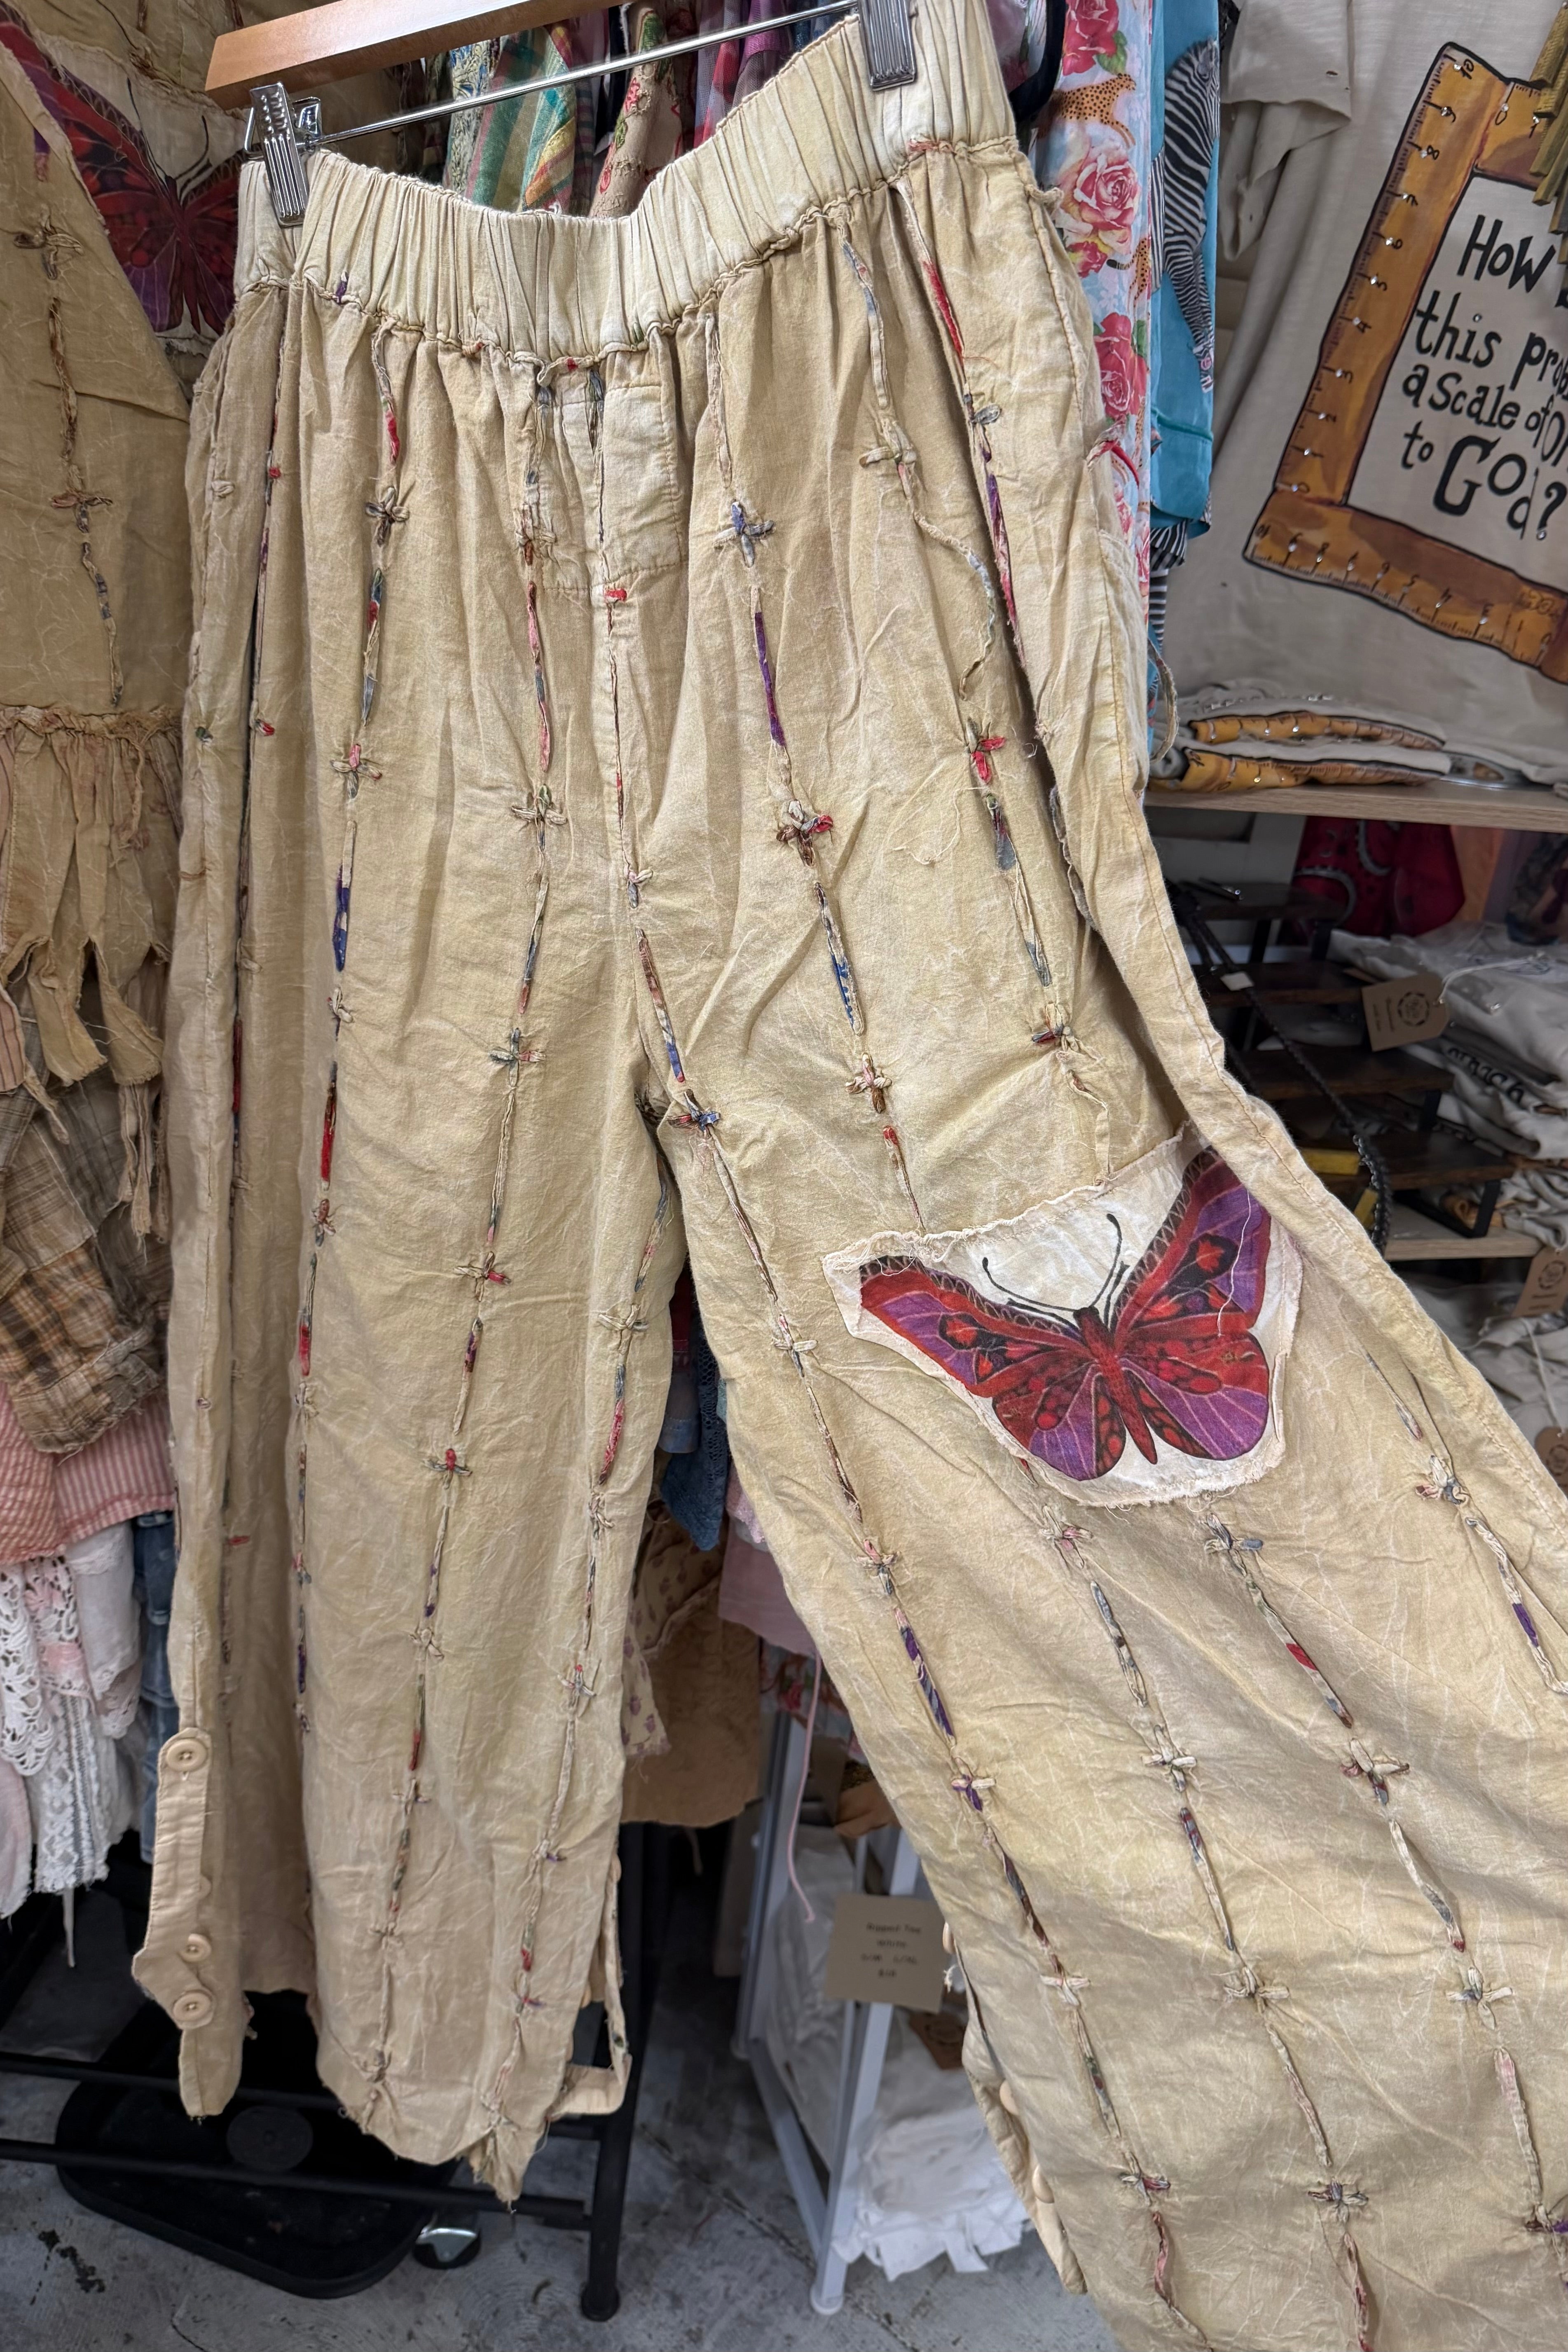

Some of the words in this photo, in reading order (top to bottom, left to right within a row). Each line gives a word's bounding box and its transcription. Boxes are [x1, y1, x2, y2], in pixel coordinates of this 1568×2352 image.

[1427, 145, 1440, 160] 8
[1357, 321, 1372, 334] 4
[1416, 290, 1502, 367] this
[1509, 332, 1568, 400] prob
[1525, 393, 1554, 449] of
[1401, 421, 1435, 470] to
[1432, 435, 1566, 540] God?
